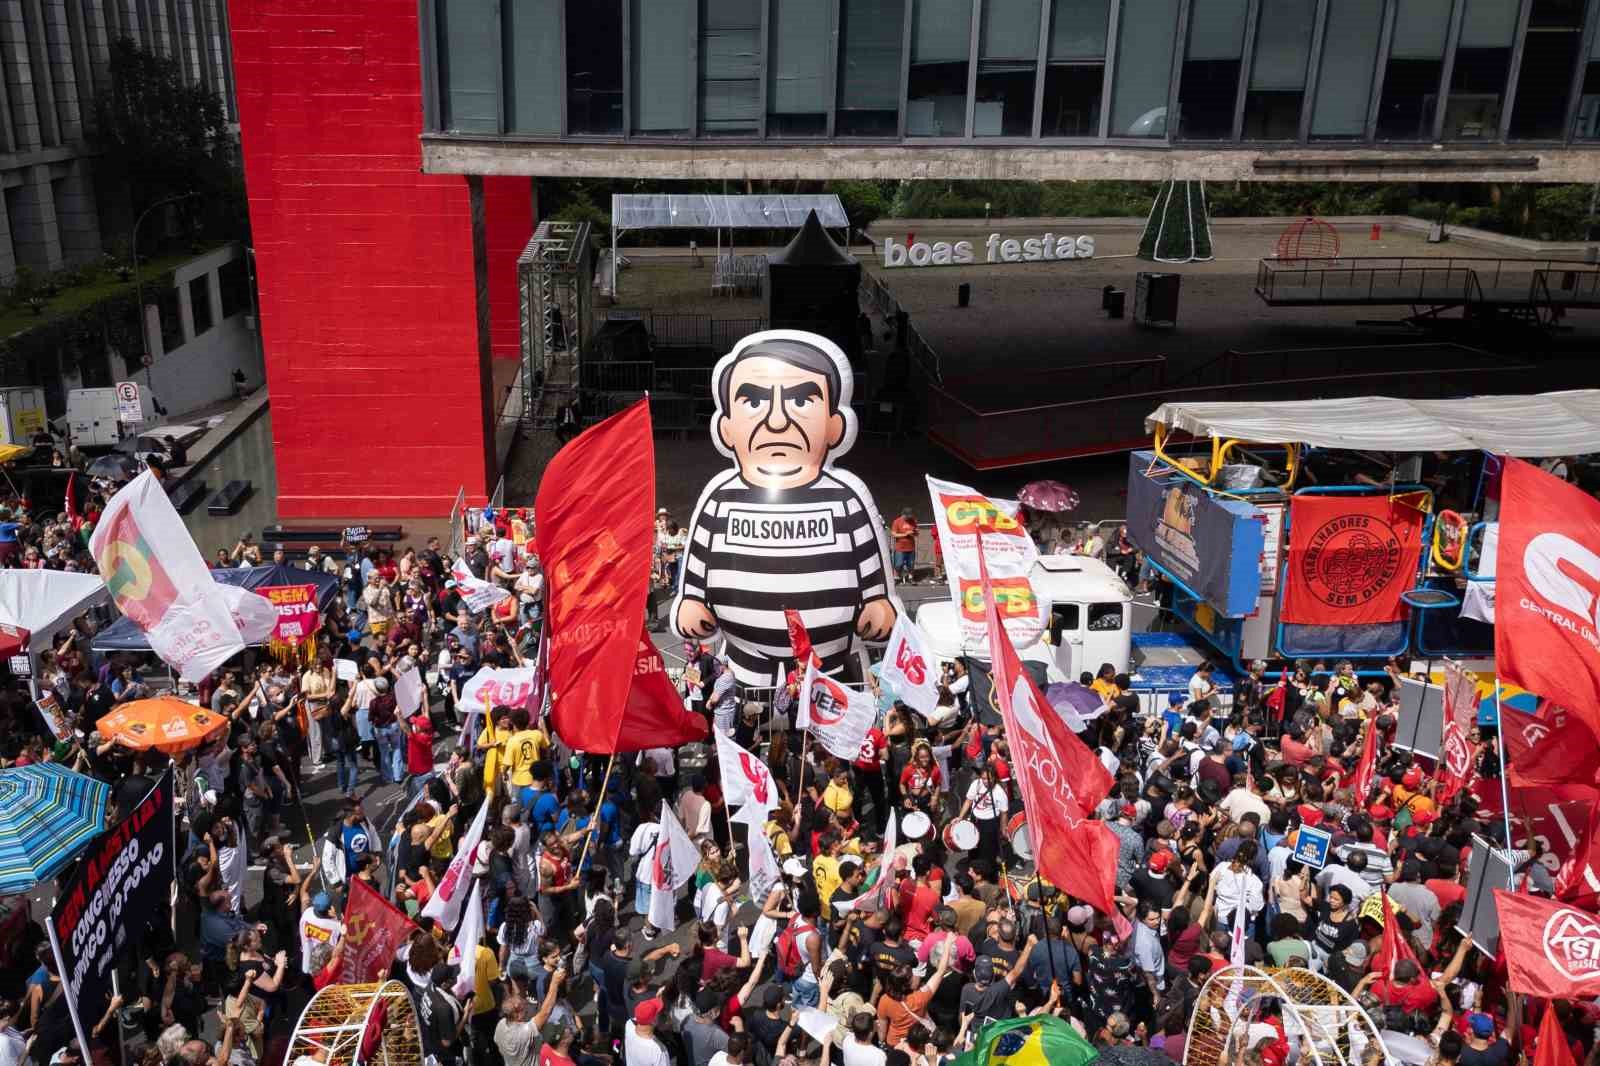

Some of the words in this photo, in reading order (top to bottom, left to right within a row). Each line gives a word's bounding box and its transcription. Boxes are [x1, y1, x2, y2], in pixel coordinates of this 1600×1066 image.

[884, 237, 975, 267] boas
[986, 233, 1094, 263] festas
[124, 386, 132, 398] E
[731, 518, 828, 539] BOLSONARO
[1306, 517, 1369, 582] TRABALHADORES
[1327, 592, 1357, 605] SEM
[1362, 538, 1398, 600] DIREITOS
[268, 587, 309, 605] SEM
[1520, 598, 1579, 633] CENTRAL
[72, 837, 139, 957] CONGRESSO
[109, 892, 122, 931] DO
